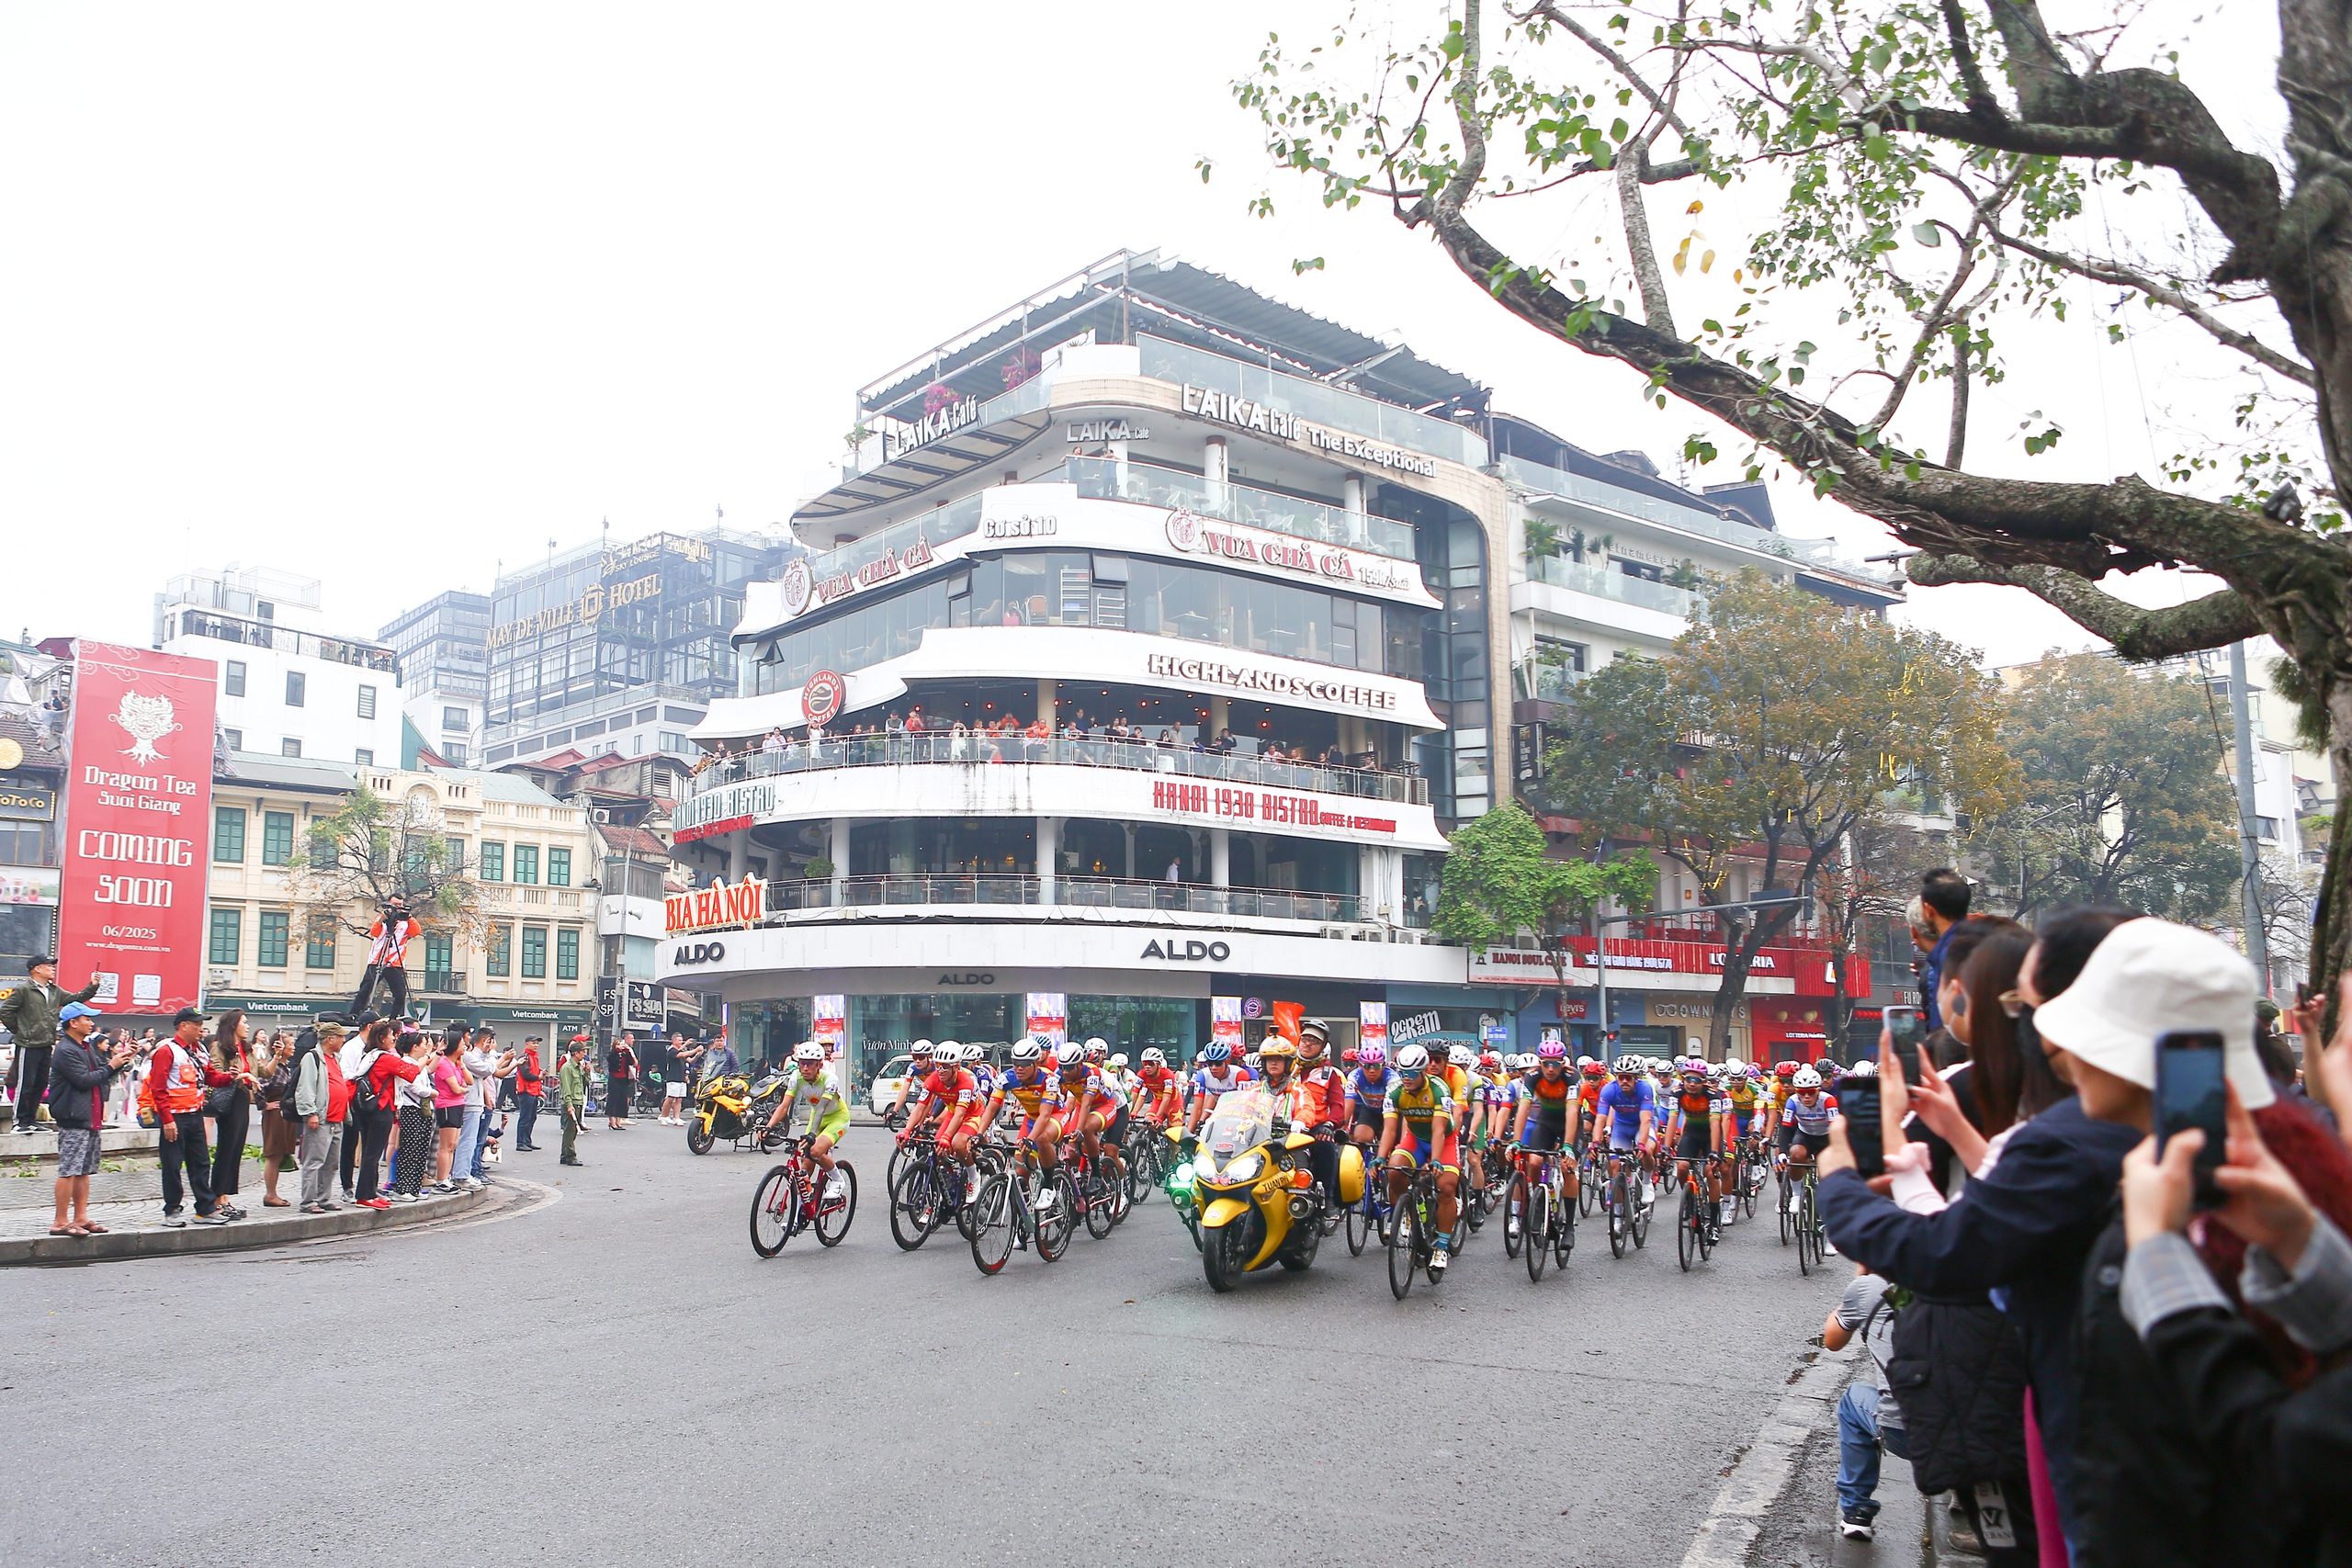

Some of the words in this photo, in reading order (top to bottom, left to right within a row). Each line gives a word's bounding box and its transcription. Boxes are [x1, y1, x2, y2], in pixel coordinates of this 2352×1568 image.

[1182, 382, 1266, 432] LAIKA
[1269, 406, 1302, 441] Café
[895, 407, 952, 457] LAIKA
[952, 395, 979, 427] Café
[1066, 420, 1131, 443] LAIKA
[1135, 426, 1149, 439] Café
[1308, 426, 1342, 453] The
[1343, 436, 1438, 478] Exceptional
[983, 518, 1006, 537] Cơ
[1011, 514, 1030, 537] sở
[1035, 516, 1057, 536] 10
[615, 562, 628, 572] SKY
[1202, 530, 1258, 561] VUA
[1262, 541, 1317, 573] CHẢ
[1320, 551, 1355, 581] CÁ
[816, 571, 854, 603] VUA
[858, 547, 900, 587] CHẢ
[903, 536, 933, 569] CÁ
[486, 626, 514, 651] MAY
[516, 616, 535, 640] DE
[537, 604, 574, 633] VILLE
[609, 573, 662, 611] HOTEL
[804, 673, 840, 701] HIGHLANDS
[1148, 653, 1306, 696] HIGHLANDS
[1307, 680, 1396, 710] COFFEE
[85, 765, 158, 792] Dragon
[163, 774, 197, 795] Tea
[97, 791, 135, 808] Suoi
[139, 795, 182, 816] Giang
[695, 790, 723, 822] 1930
[726, 784, 775, 817] BISTRO
[1153, 781, 1208, 813] HANOI
[1214, 787, 1254, 818] 1930
[1262, 794, 1319, 826] BISTRO
[79, 829, 193, 866] COMING
[94, 874, 173, 908] SOON
[665, 894, 695, 931] BIA
[696, 881, 723, 927] HÀ
[726, 877, 762, 930] NỘI
[102, 925, 157, 940] 06/2025
[85, 941, 171, 953] www.dragontea.com.vn
[674, 942, 725, 965] ALDO
[1140, 940, 1230, 963] ALDO
[1492, 953, 1521, 964] HANOI
[1522, 953, 1544, 966] SOUL
[1709, 953, 1775, 968] LORIA
[937, 974, 995, 986] ALDO
[247, 1002, 309, 1012] Vietcombank
[511, 1010, 559, 1020] Vietcombank
[628, 998, 642, 1012] FS
[643, 999, 663, 1015] SPA
